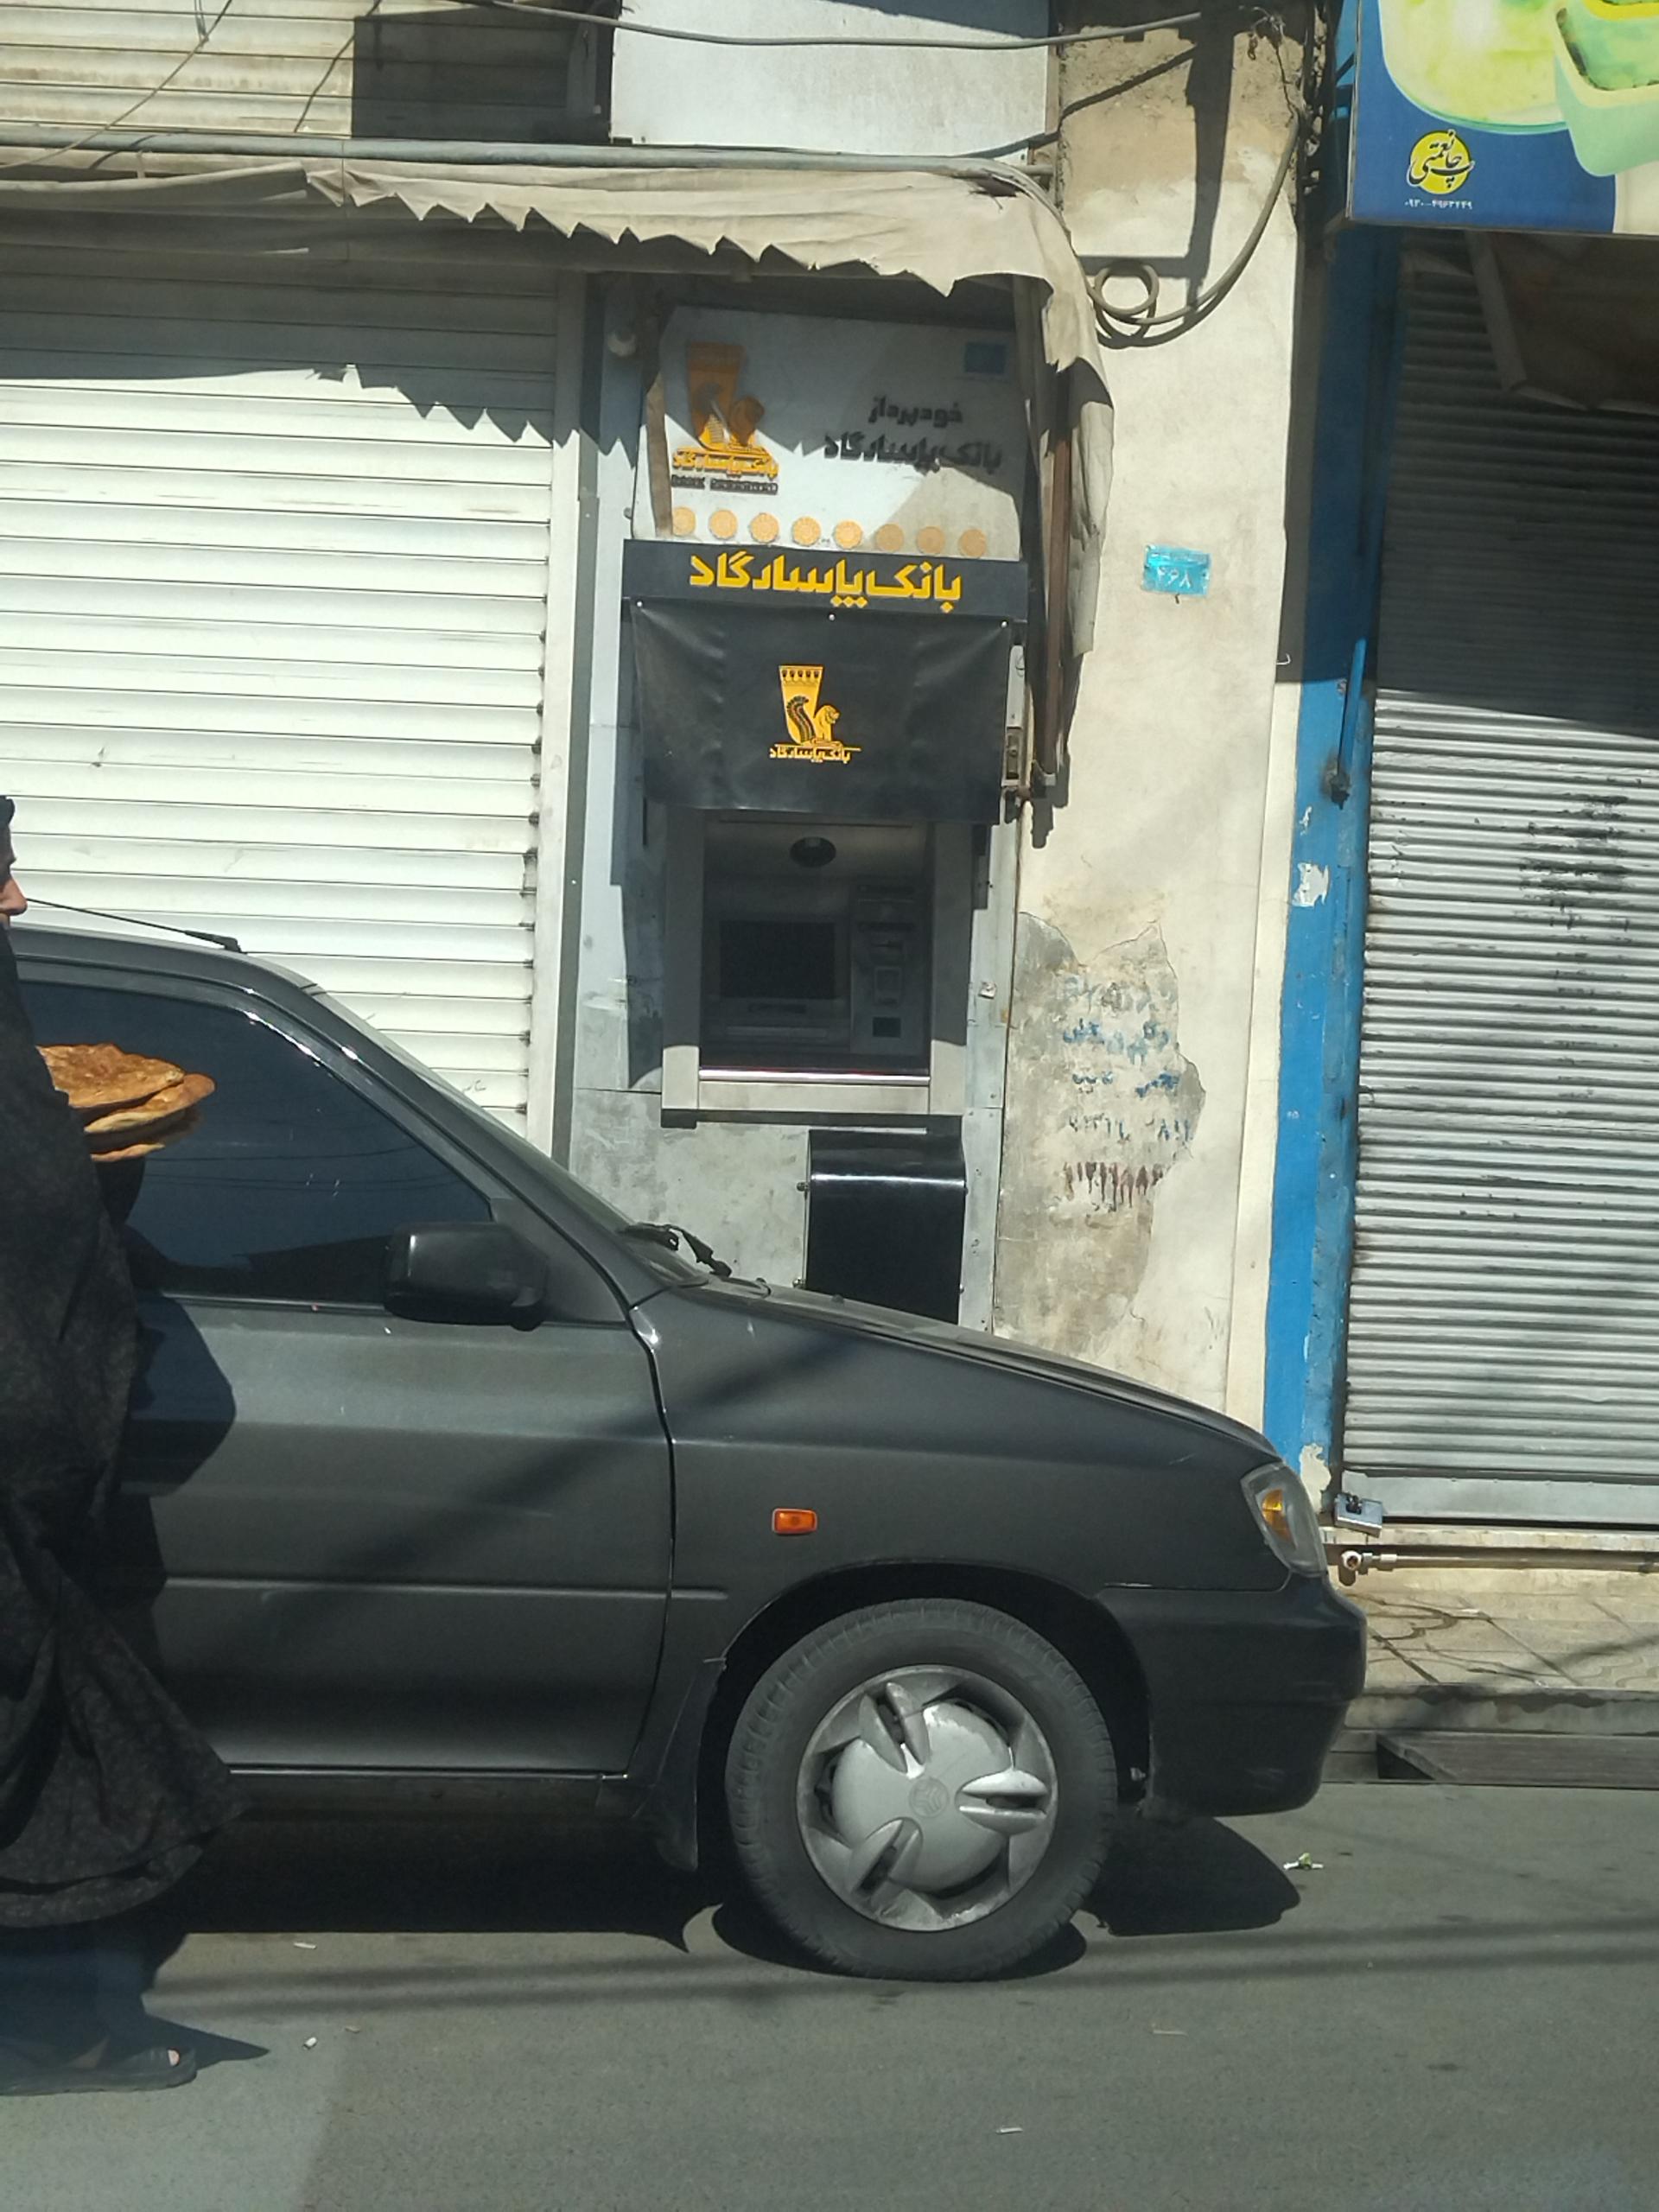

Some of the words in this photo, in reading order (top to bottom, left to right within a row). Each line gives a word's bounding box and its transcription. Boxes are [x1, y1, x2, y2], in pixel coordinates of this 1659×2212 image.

[868, 395, 963, 429] خودپرداز
[823, 431, 943, 476] پاسارگاد
[939, 440, 1002, 475] بانک
[690, 550, 868, 608] پاسارگاد
[866, 559, 963, 613] بانک
[769, 746, 823, 763] پاسارگاد
[823, 748, 851, 764] بانک
